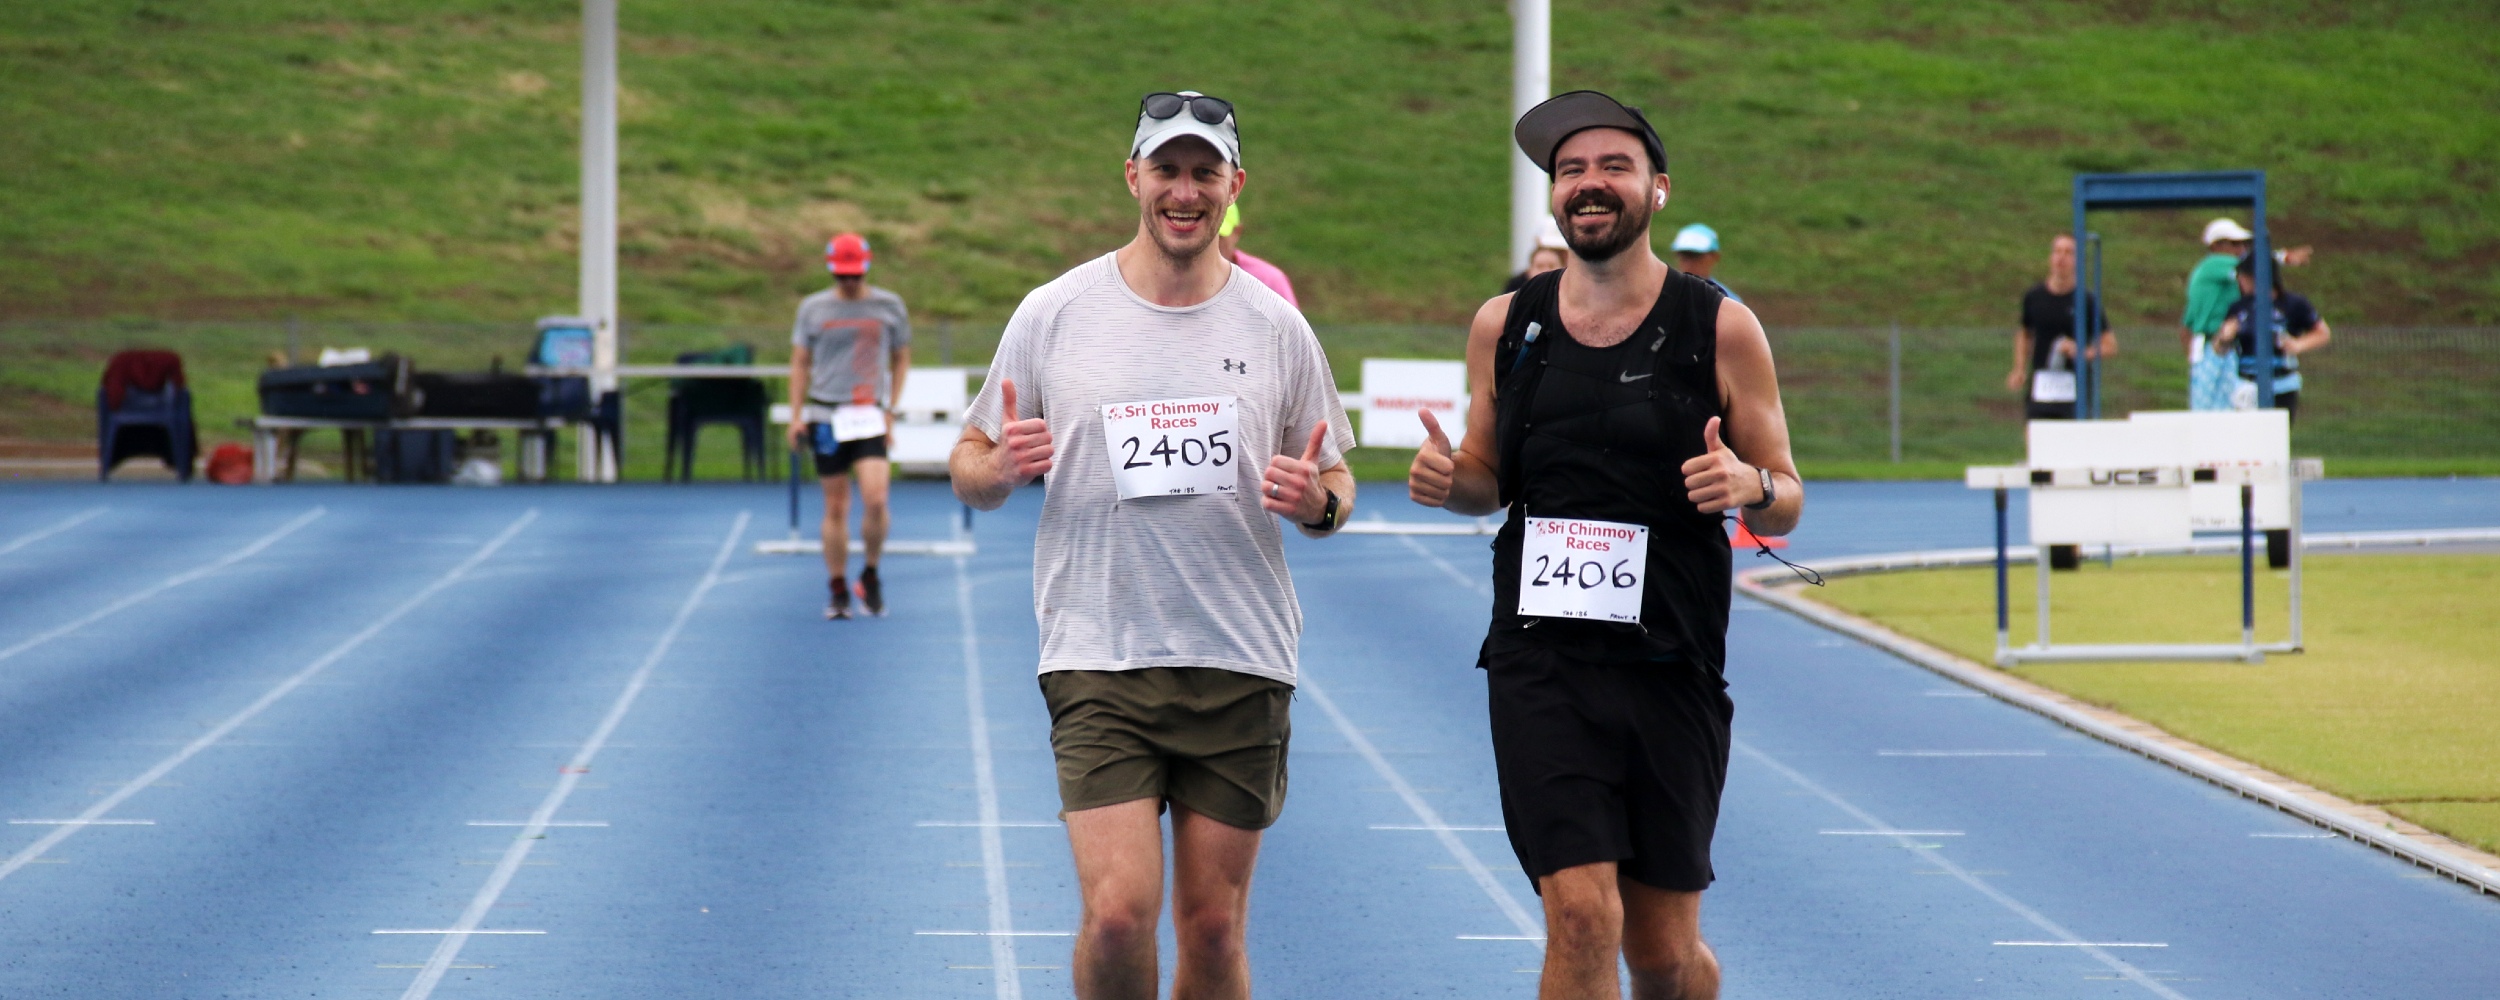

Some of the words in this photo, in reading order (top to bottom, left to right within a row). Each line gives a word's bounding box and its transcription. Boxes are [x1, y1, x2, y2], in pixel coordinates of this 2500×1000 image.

[1124, 404, 1147, 418] Sri
[1151, 402, 1220, 416] Chinmoy
[1150, 417, 1198, 430] Races
[1121, 430, 1233, 470] 2405
[2090, 469, 2158, 485] UCS
[1548, 521, 1565, 535] Sri
[1568, 522, 1636, 543] Chinmoy
[1566, 537, 1611, 552] Races
[1531, 554, 1637, 590] 2406
